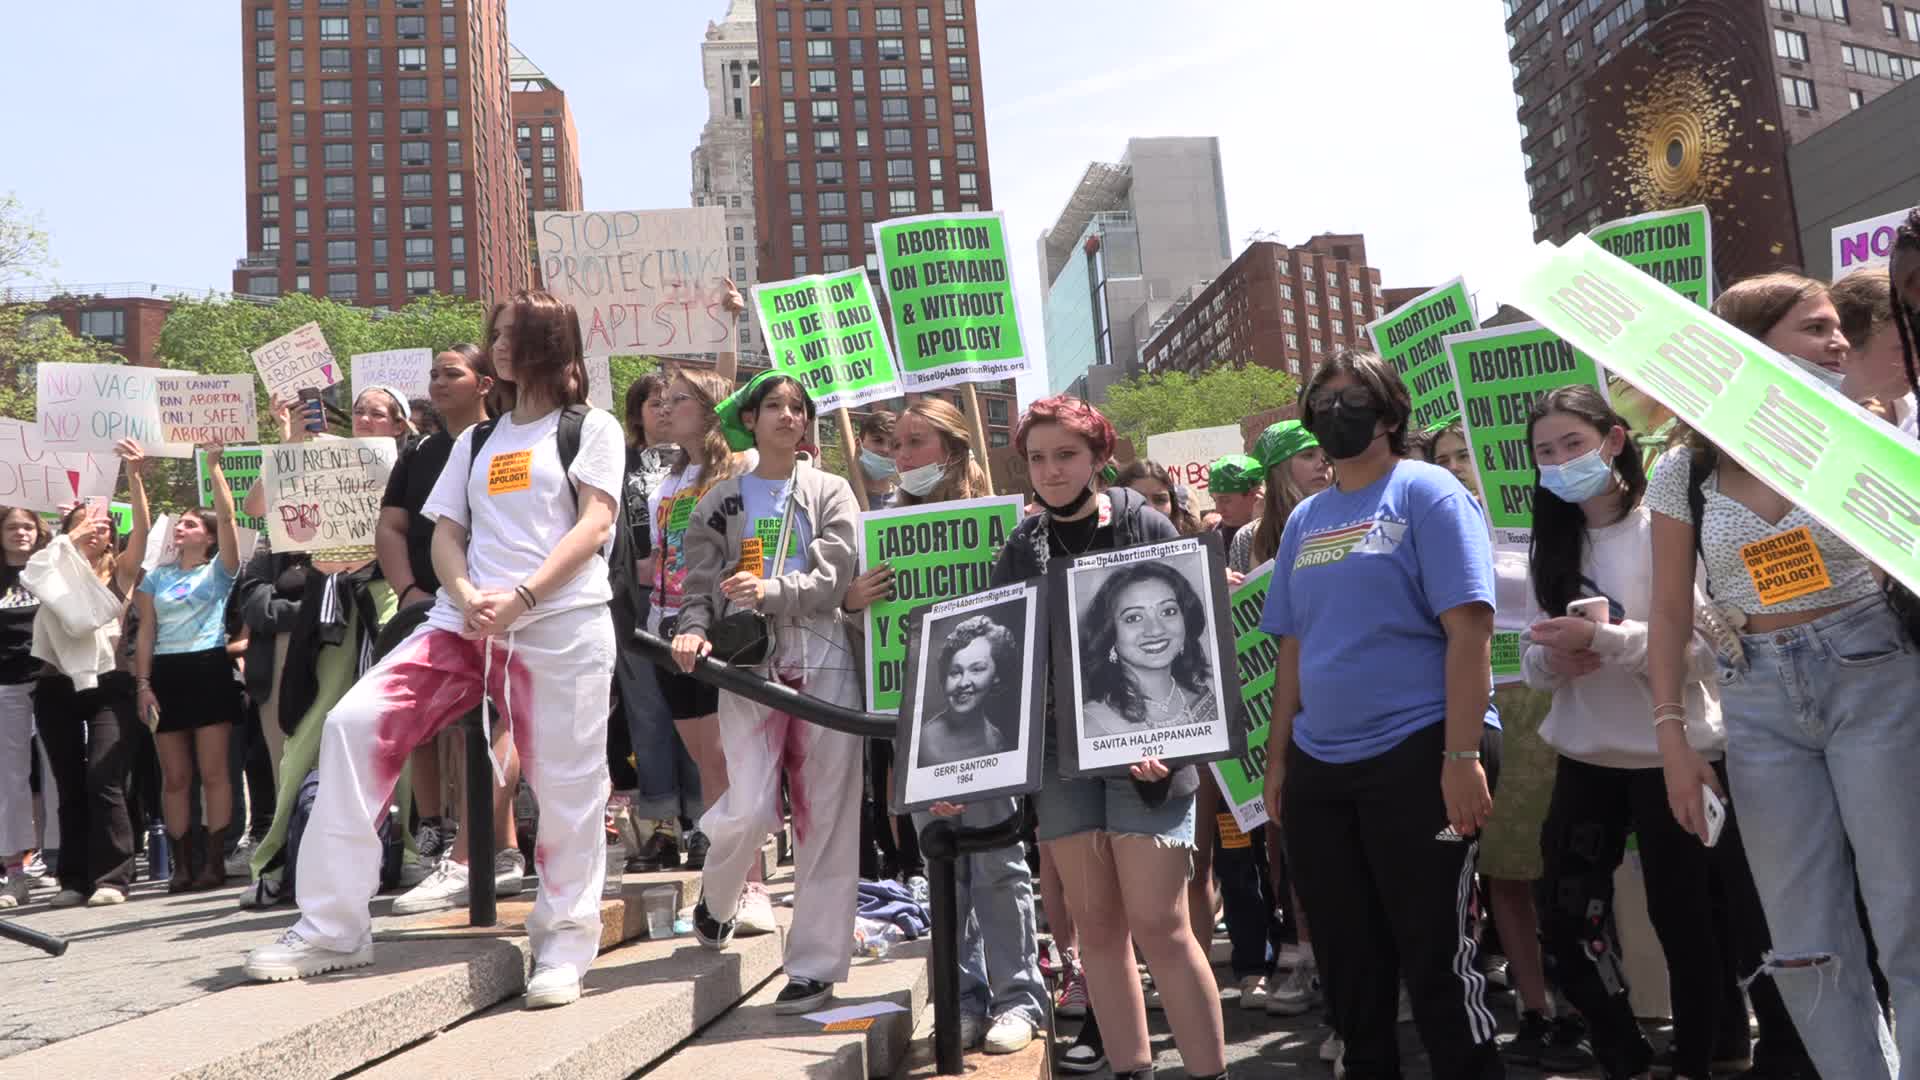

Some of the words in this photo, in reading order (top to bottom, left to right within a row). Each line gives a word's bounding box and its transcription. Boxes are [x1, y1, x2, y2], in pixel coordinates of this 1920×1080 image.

[543, 211, 640, 254] STOP
[896, 226, 990, 257] ABORTION
[545, 249, 726, 297] PROTECTING
[889, 264, 919, 292] ON
[922, 258, 1006, 287] DEMAND
[1639, 255, 1703, 285] MAND
[773, 281, 855, 314] ABORTION
[903, 303, 916, 326] &
[920, 291, 1005, 321] WITHOUT
[586, 301, 729, 350] APISTS
[771, 320, 796, 342] ON
[799, 304, 873, 336] DEMAND
[1386, 295, 1457, 348] ABORTION
[256, 340, 291, 368] KEEP
[784, 349, 796, 367] &
[800, 330, 875, 363] WITHOUT
[916, 325, 1002, 359] APOLOGY
[800, 357, 874, 390] APOLOGY
[917, 361, 1025, 385] RiseUp4AbortionRights.org
[1468, 338, 1576, 384] ABORTION
[47, 372, 82, 397] NO
[158, 380, 179, 391] YOU
[186, 380, 231, 391] CANNOT
[43, 411, 81, 438] NO
[162, 411, 193, 425] ONLY
[203, 408, 240, 426] SAFE
[1467, 395, 1495, 428] ON
[171, 425, 246, 442] ABORTION
[219, 455, 263, 470] BORTIO
[273, 448, 296, 475] YOU
[358, 447, 387, 472] PR
[1483, 443, 1497, 472] &
[279, 503, 321, 536] PRO
[323, 495, 381, 518] CONTR
[322, 520, 345, 540] OF
[758, 519, 783, 528] FORC
[877, 516, 979, 560] ¡ABORTO
[988, 515, 1006, 548] A
[1743, 529, 1806, 559] ABORTION
[1748, 556, 1763, 568] ON
[1764, 542, 1810, 562] DEMAND
[1763, 552, 1815, 576] WITHOUT
[1757, 563, 1822, 592] APOLOGY!
[876, 616, 891, 648] Y
[1092, 737, 1128, 751] SAVITA
[1129, 726, 1213, 747] HALAPPANAVAR
[1141, 745, 1164, 757] 2012
[934, 764, 958, 778] GERRI
[959, 757, 999, 773] SANTORO
[956, 773, 974, 785] 1964
